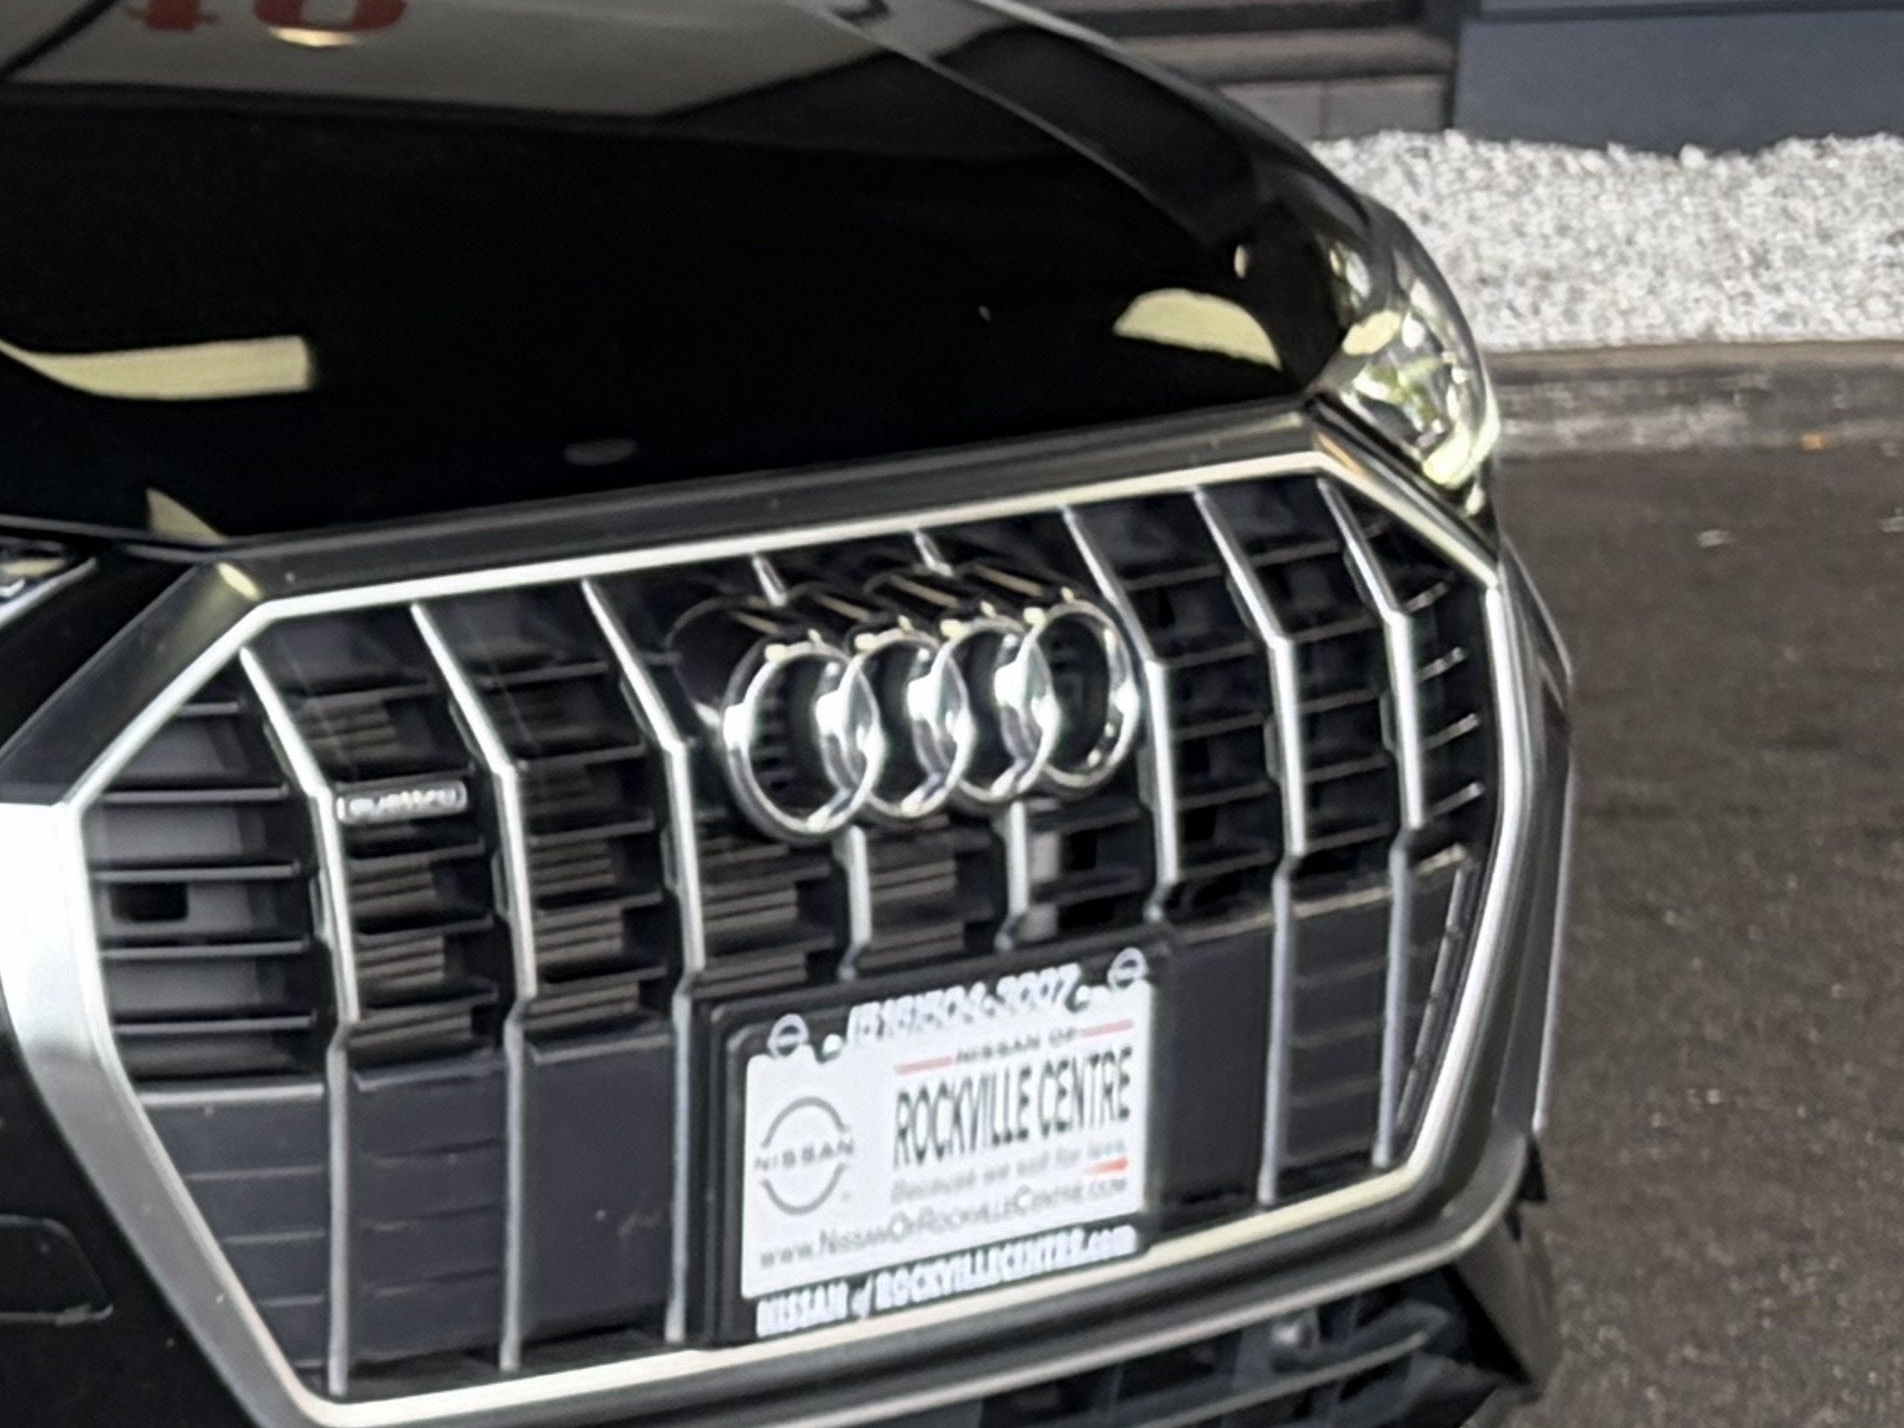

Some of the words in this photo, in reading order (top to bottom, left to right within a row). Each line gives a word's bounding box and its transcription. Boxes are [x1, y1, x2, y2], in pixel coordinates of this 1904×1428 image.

[892, 1065, 1032, 1168] ROCKVILLE
[1037, 1045, 1133, 1138] CENTRE
[754, 1138, 855, 1171] NISSAN
